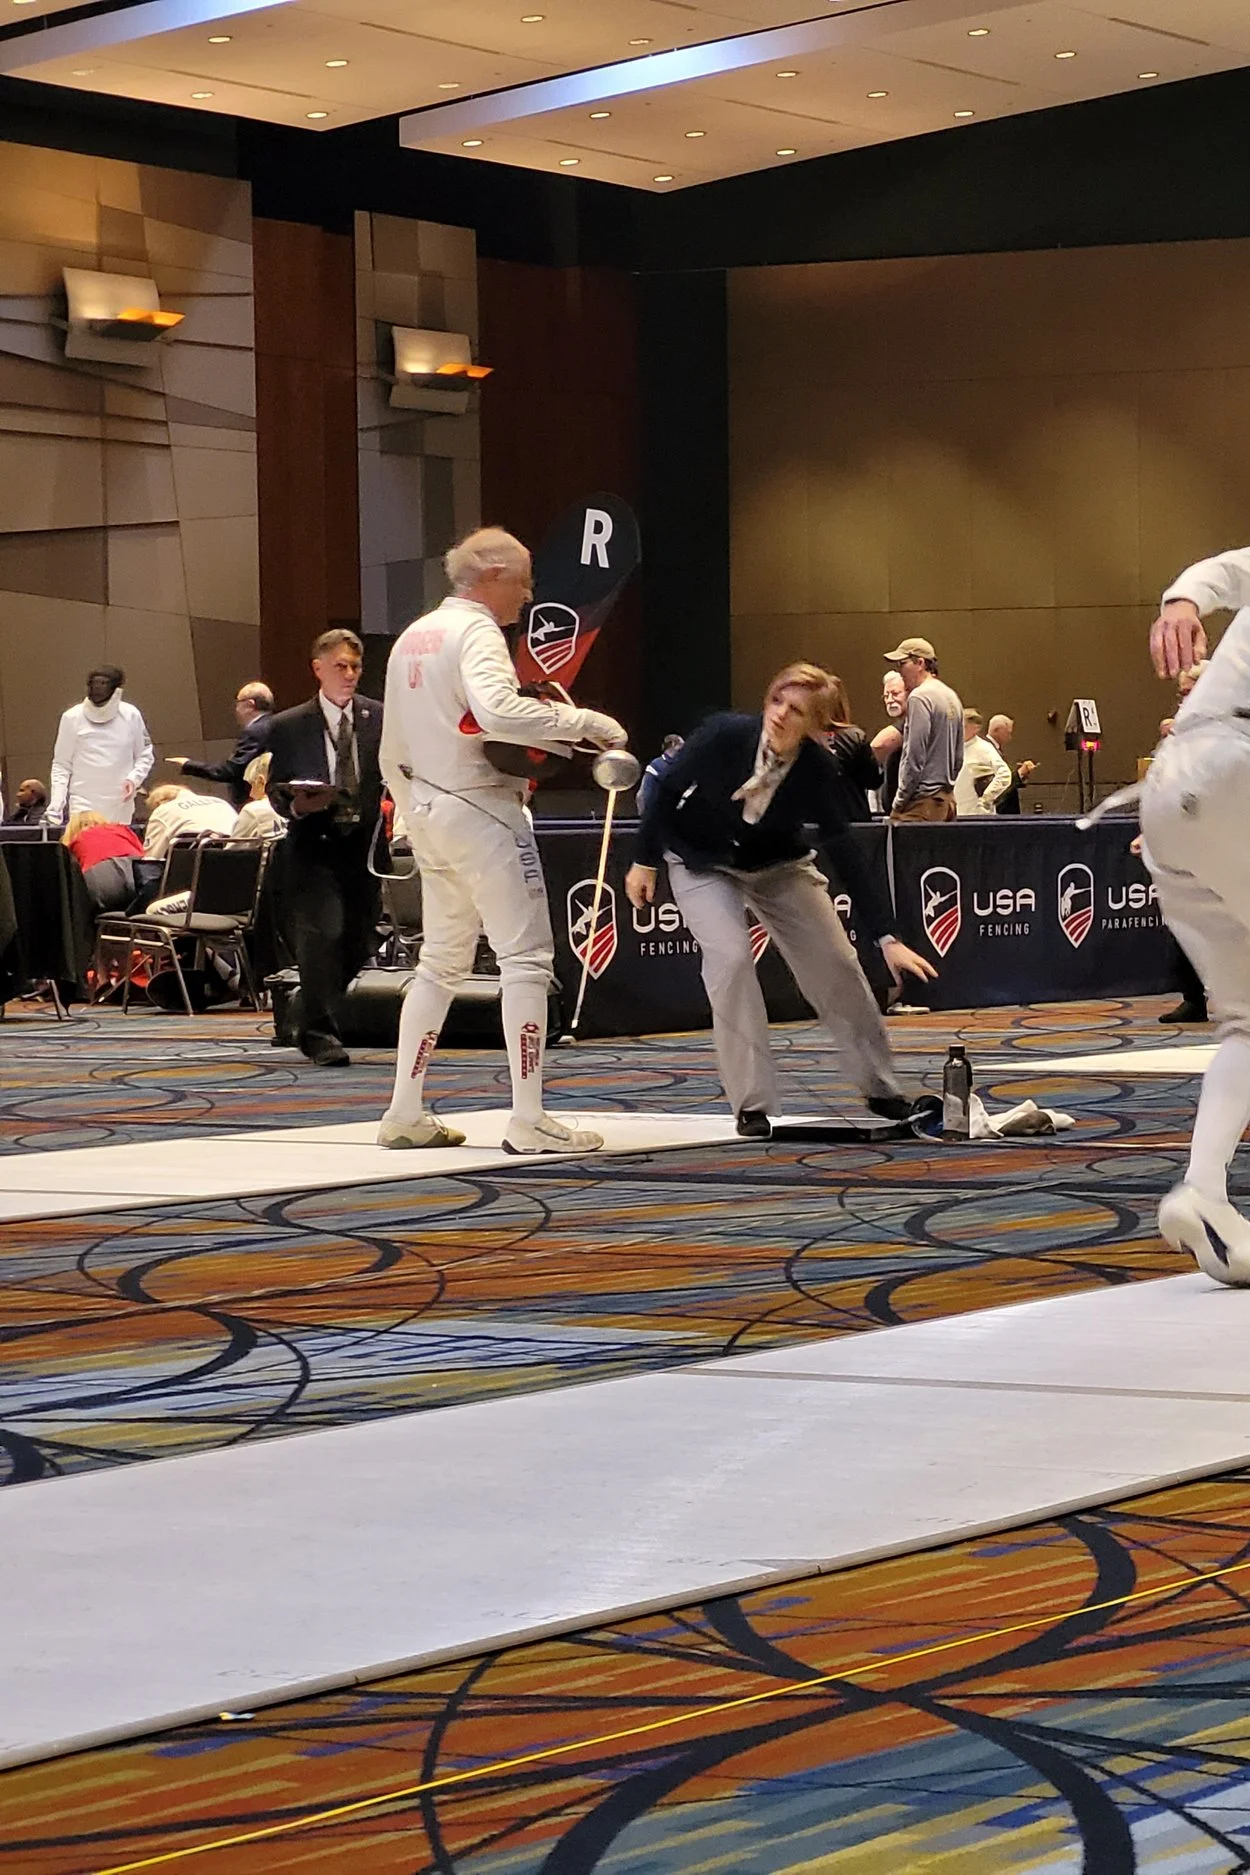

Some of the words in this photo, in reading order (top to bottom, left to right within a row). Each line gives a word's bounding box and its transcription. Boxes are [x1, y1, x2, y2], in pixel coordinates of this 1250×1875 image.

[580, 508, 613, 569] R
[1083, 707, 1093, 727] R
[973, 888, 1035, 916] USA
[632, 903, 687, 933] US
[1101, 915, 1168, 930] PARAFENCIN
[979, 923, 1030, 937] FENCING
[640, 940, 699, 956] FENCING
